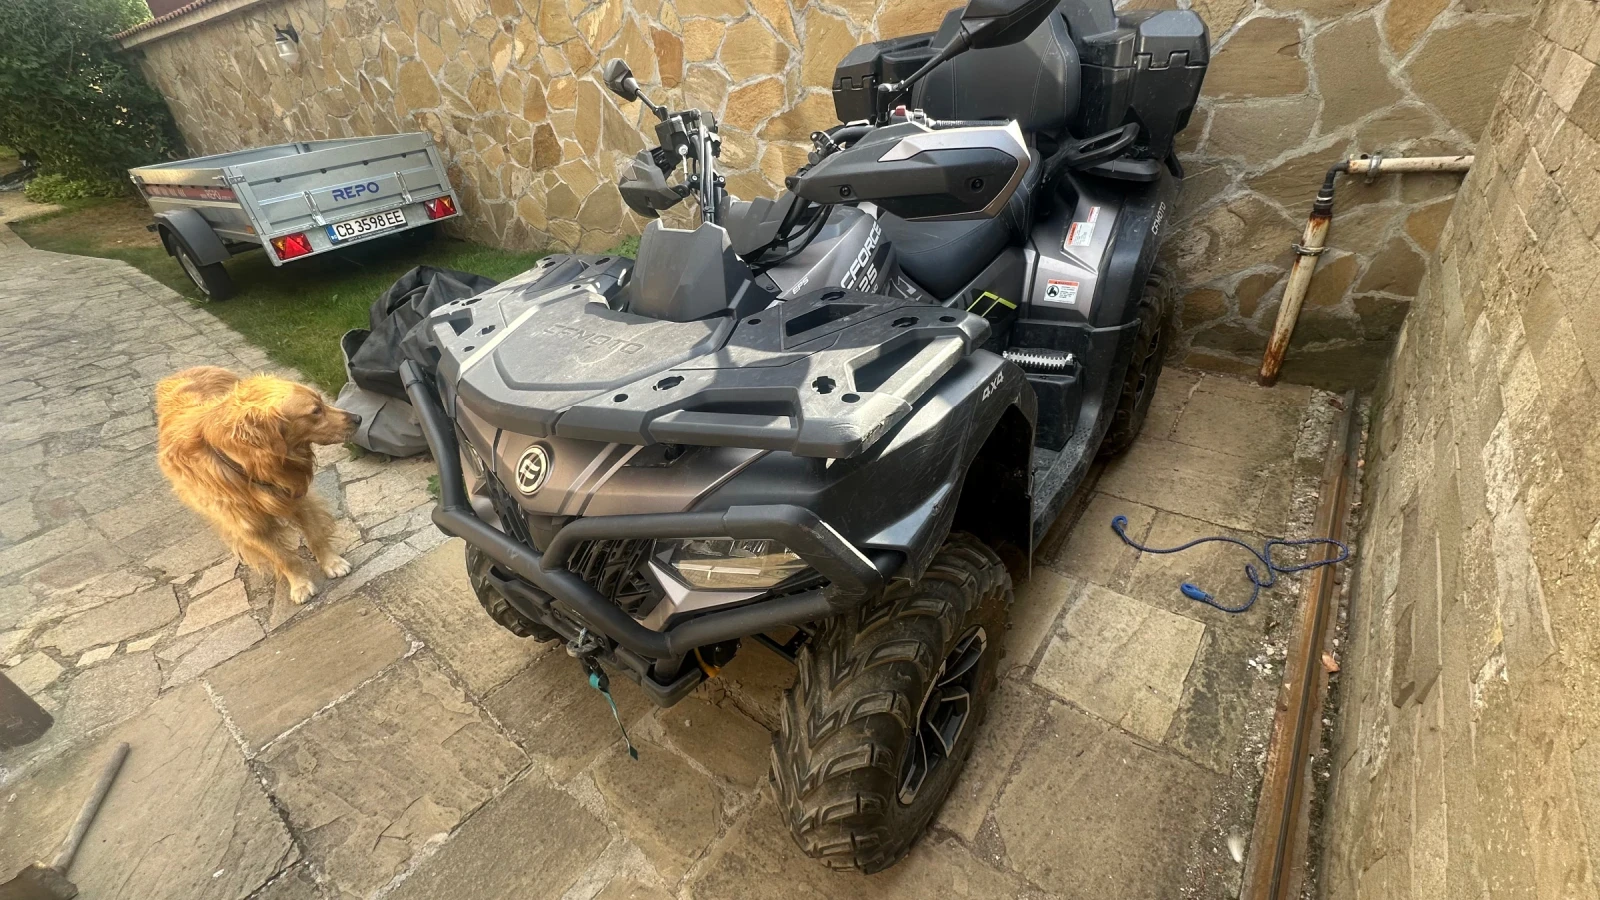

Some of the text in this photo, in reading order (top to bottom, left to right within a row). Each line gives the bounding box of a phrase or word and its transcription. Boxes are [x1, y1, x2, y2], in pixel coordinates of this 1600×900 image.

[332, 181, 380, 202] REPO
[336, 222, 355, 238] CB
[355, 215, 386, 233] 3598
[385, 210, 404, 225] EE
[1151, 201, 1167, 236] CFMOTO
[840, 220, 882, 290] CFORCE
[792, 276, 809, 295] EPS
[856, 262, 878, 293] 25
